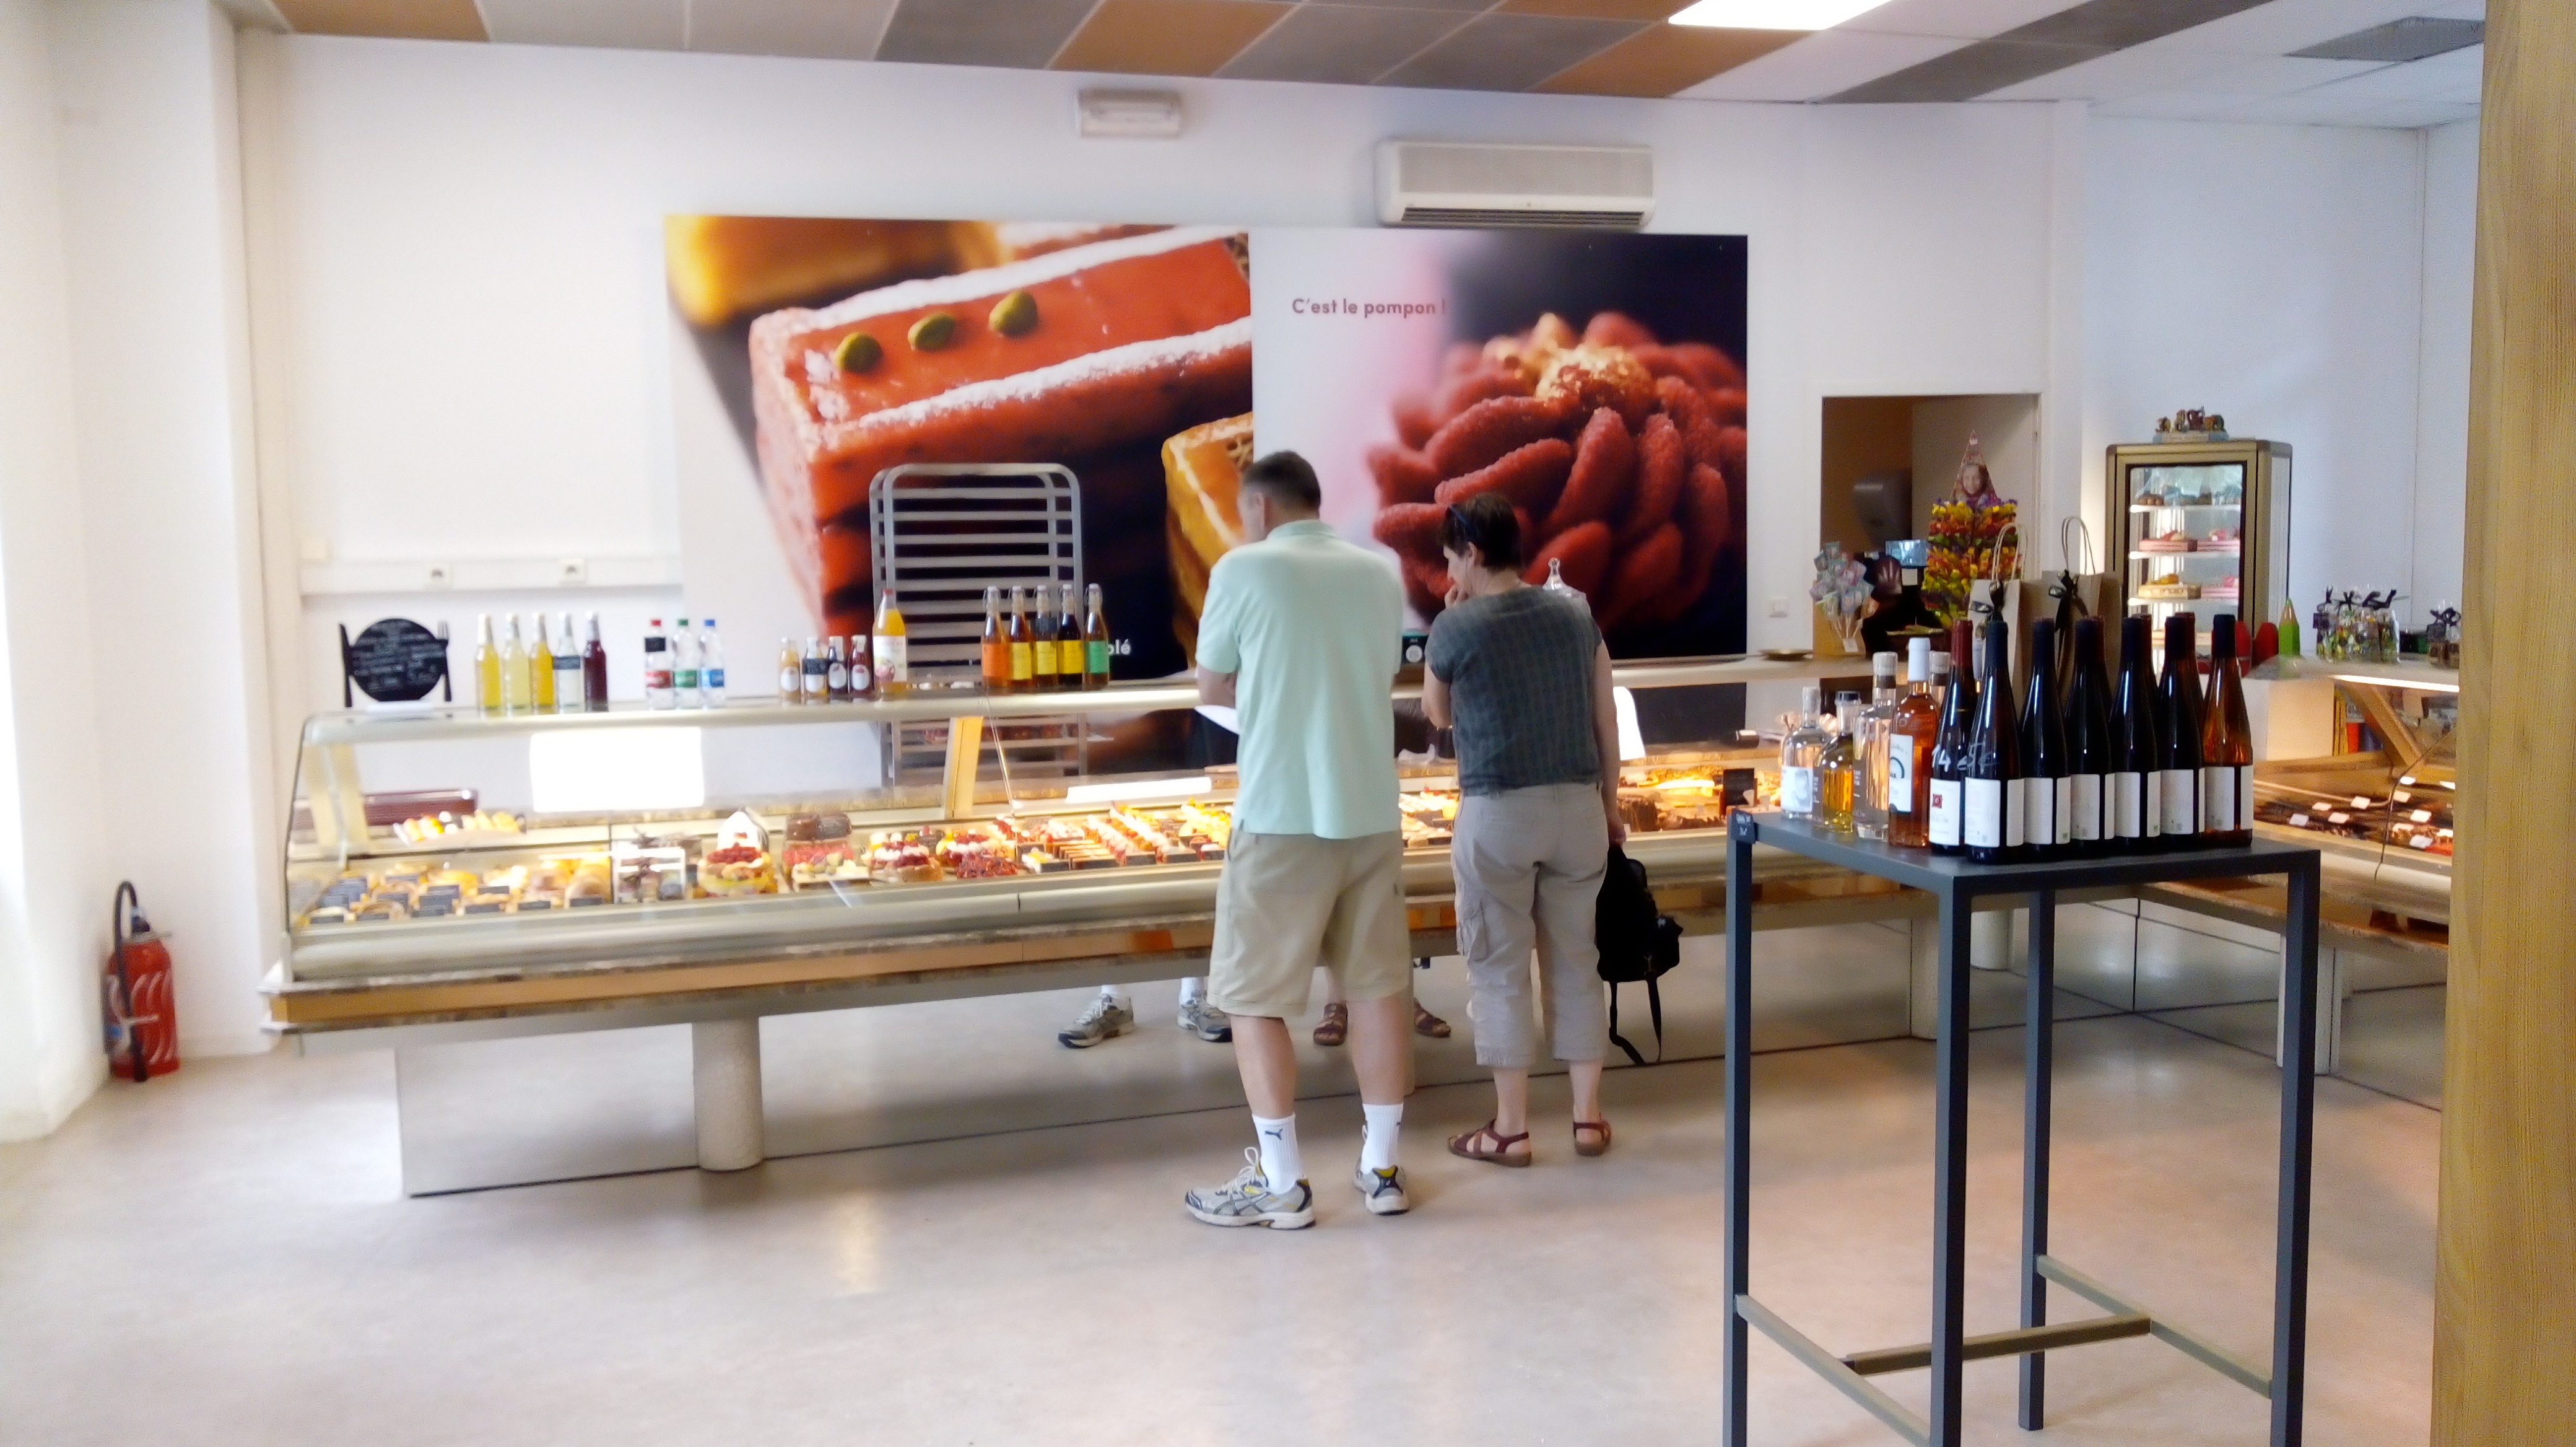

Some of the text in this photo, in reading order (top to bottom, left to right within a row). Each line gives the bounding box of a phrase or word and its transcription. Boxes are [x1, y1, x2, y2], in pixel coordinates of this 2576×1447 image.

[1292, 297, 1447, 318] C'est le pompon !
